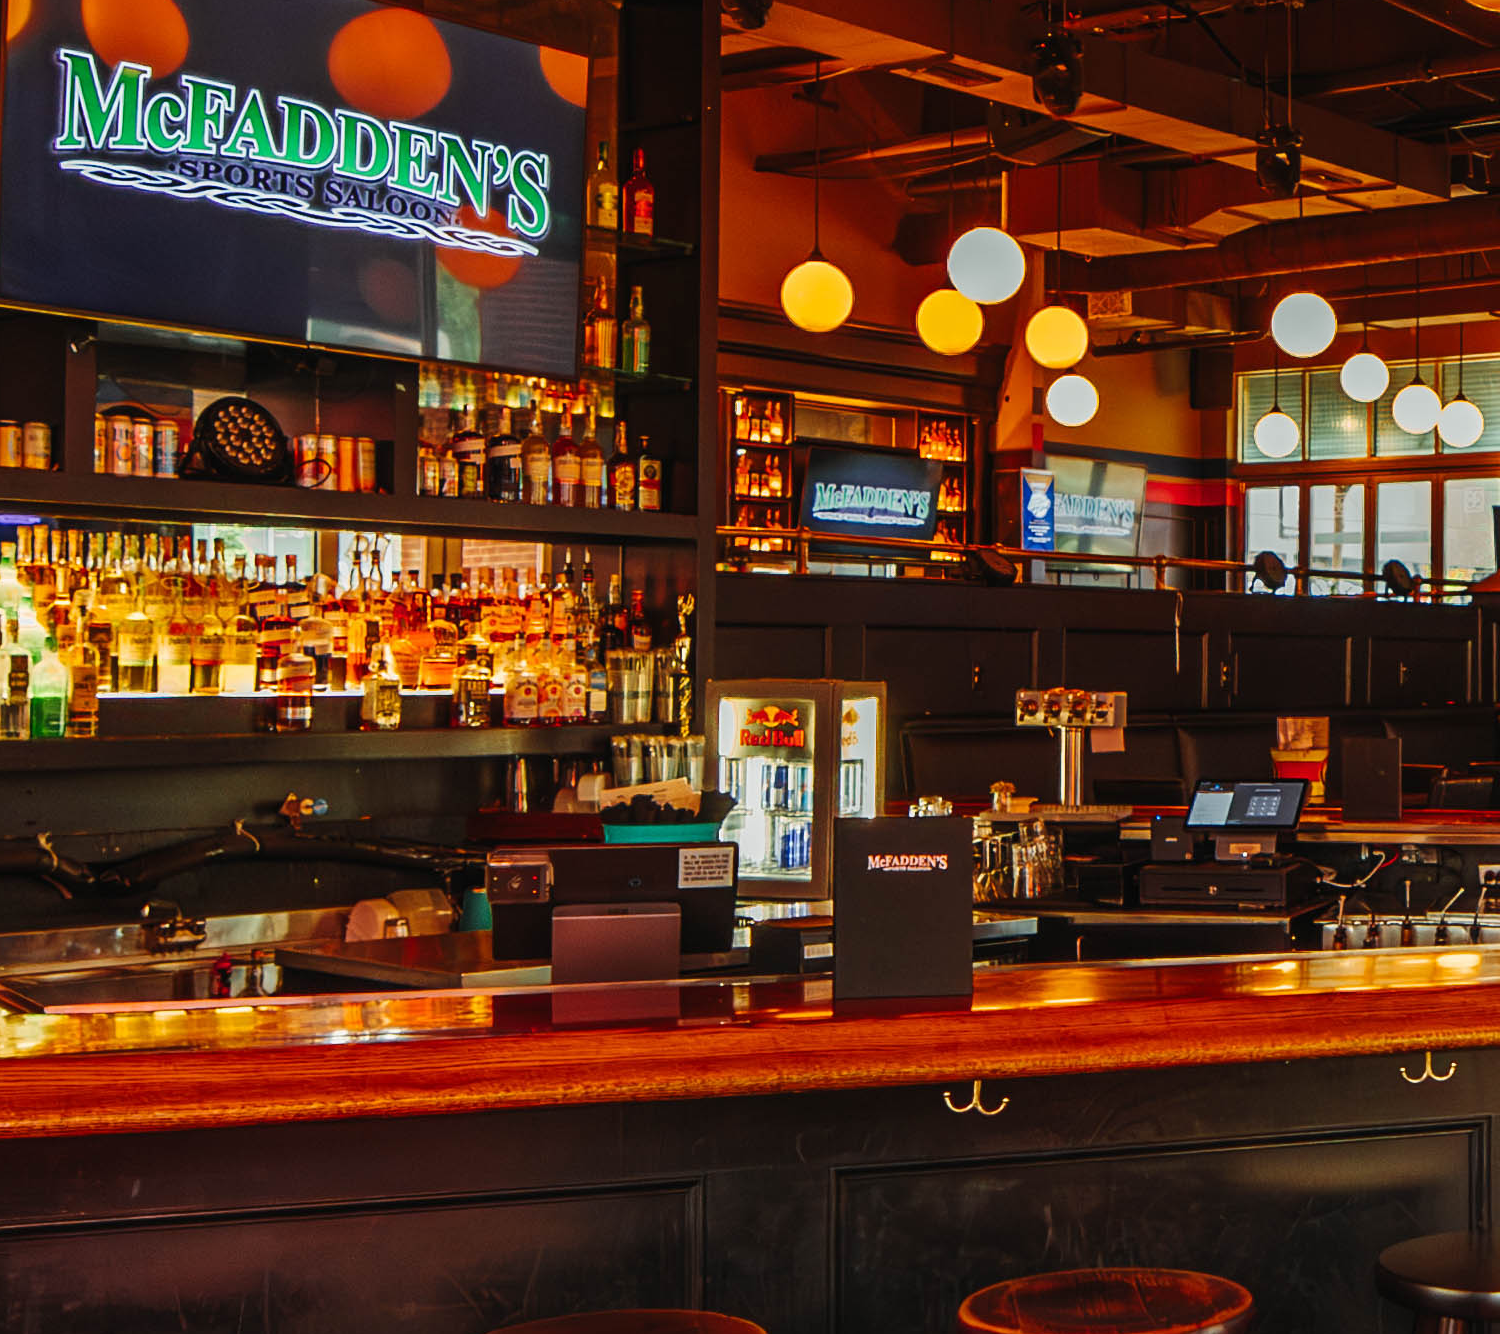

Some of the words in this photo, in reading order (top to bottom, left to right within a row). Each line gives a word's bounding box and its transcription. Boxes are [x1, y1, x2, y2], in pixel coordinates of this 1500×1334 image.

[54, 47, 551, 240] McFADDEN'S
[178, 159, 314, 199] SPORTS
[324, 180, 453, 226] SALOON
[812, 482, 931, 519] McFADDEN'S
[740, 728, 771, 747] Red
[772, 729, 805, 747] Bull
[867, 853, 948, 870] McFADDEN'S
